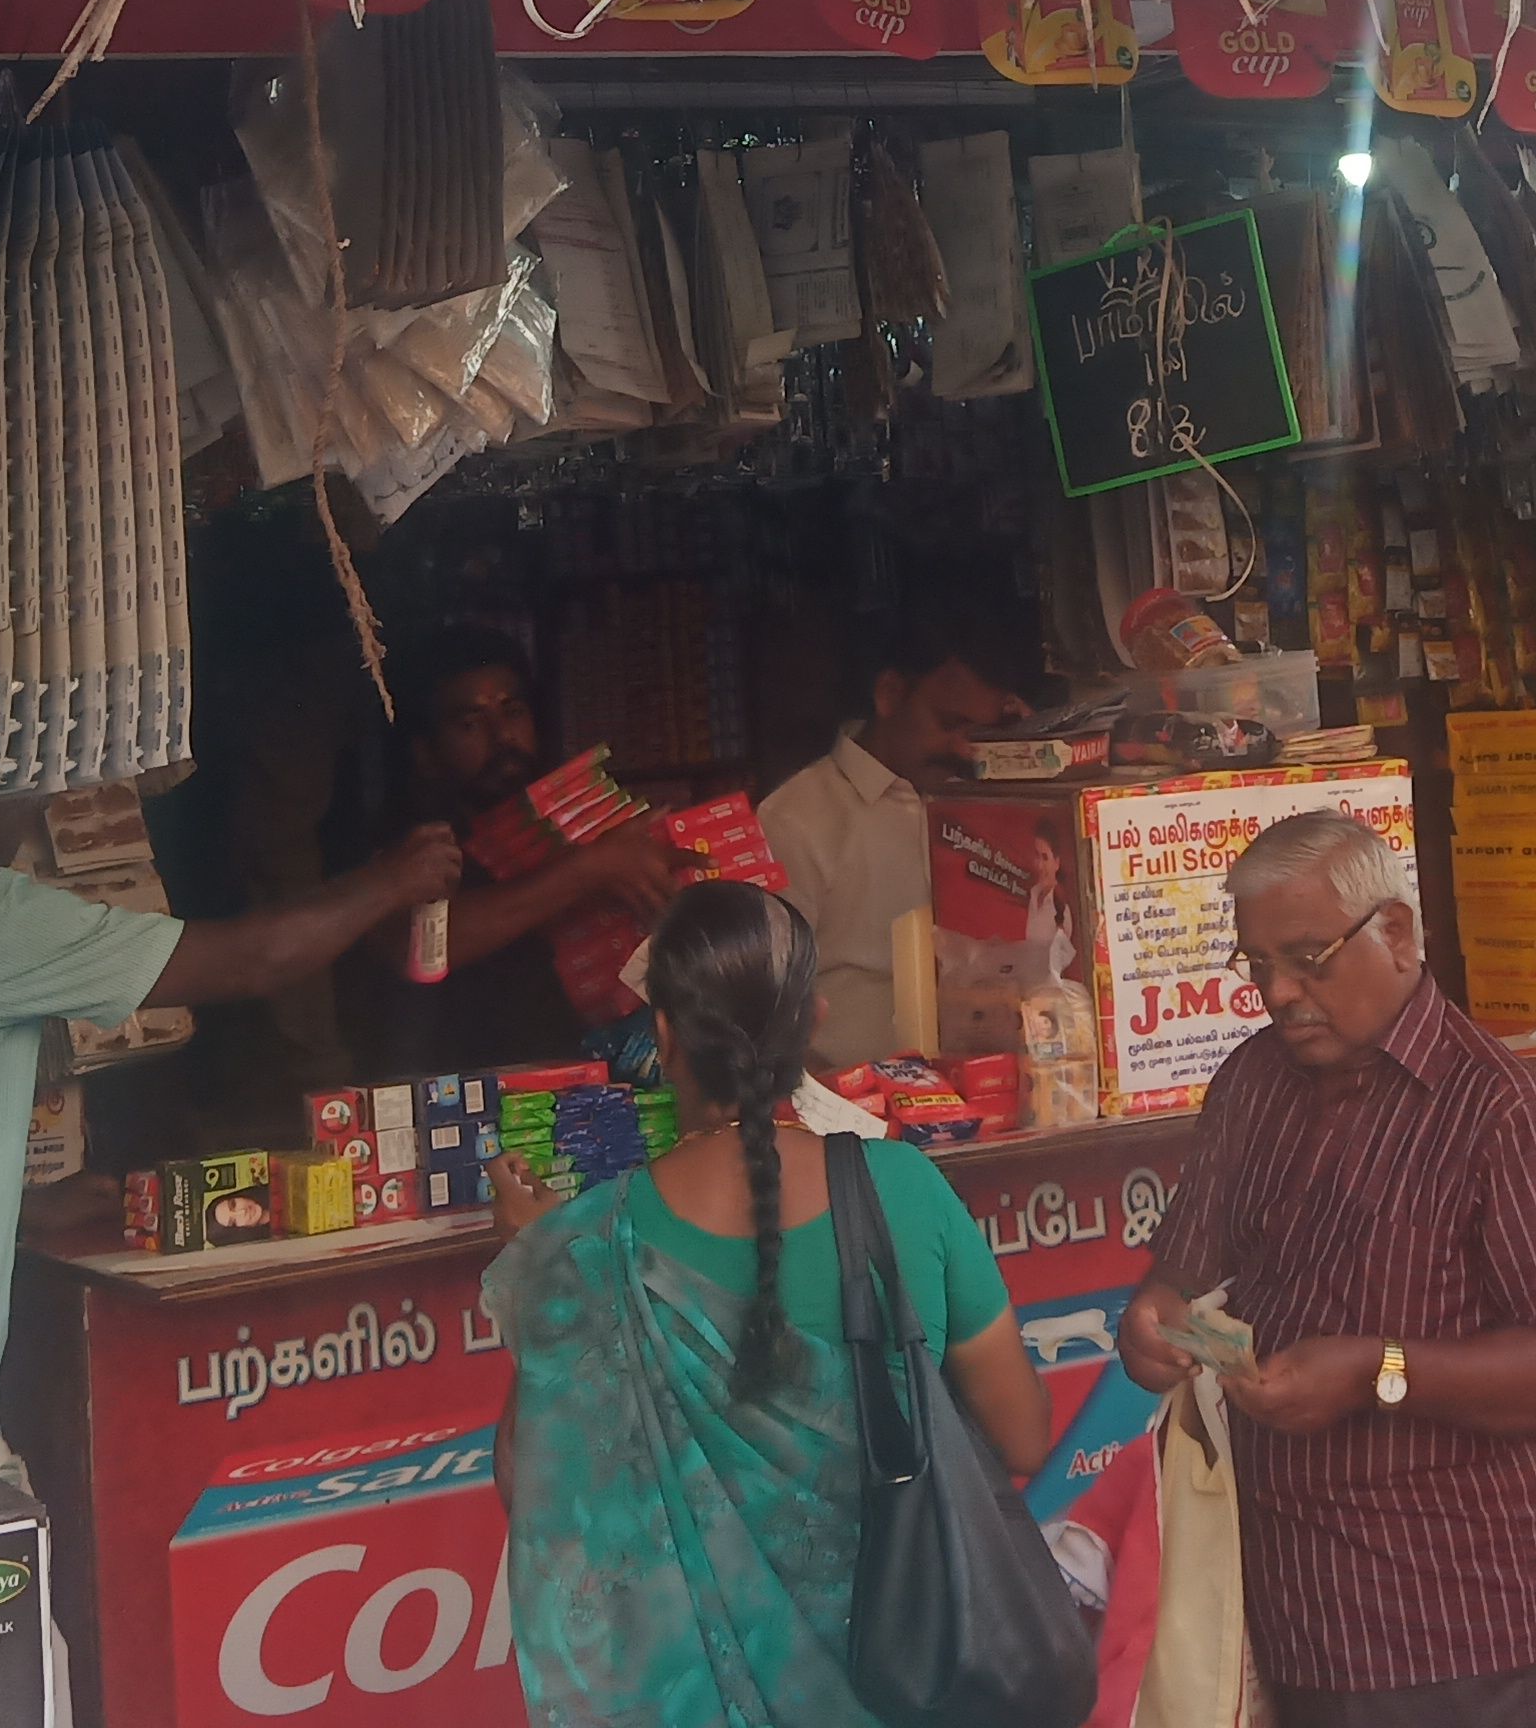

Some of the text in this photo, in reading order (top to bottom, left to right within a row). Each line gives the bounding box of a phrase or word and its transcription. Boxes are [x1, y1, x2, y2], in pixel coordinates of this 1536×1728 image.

[855, 6, 906, 45] cup
[1219, 30, 1296, 54] GOLD
[1231, 53, 1290, 88] cup
[1106, 809, 1262, 851] பல் வலிகளுக்கு
[1128, 850, 1177, 878] Full
[1455, 846, 1514, 857] EXPORT
[1133, 938, 1237, 961] பல் பொடிபடுகிறத
[1129, 976, 1224, 1036] J.M
[1474, 1000, 1531, 1012] QUALITY
[1128, 1040, 1173, 1057] மூலிகை
[1176, 1029, 1218, 1047] பல்வலி
[177, 1297, 438, 1420] பற்களில்
[227, 1424, 458, 1479] Colgate
[302, 1446, 494, 1505] Salt
